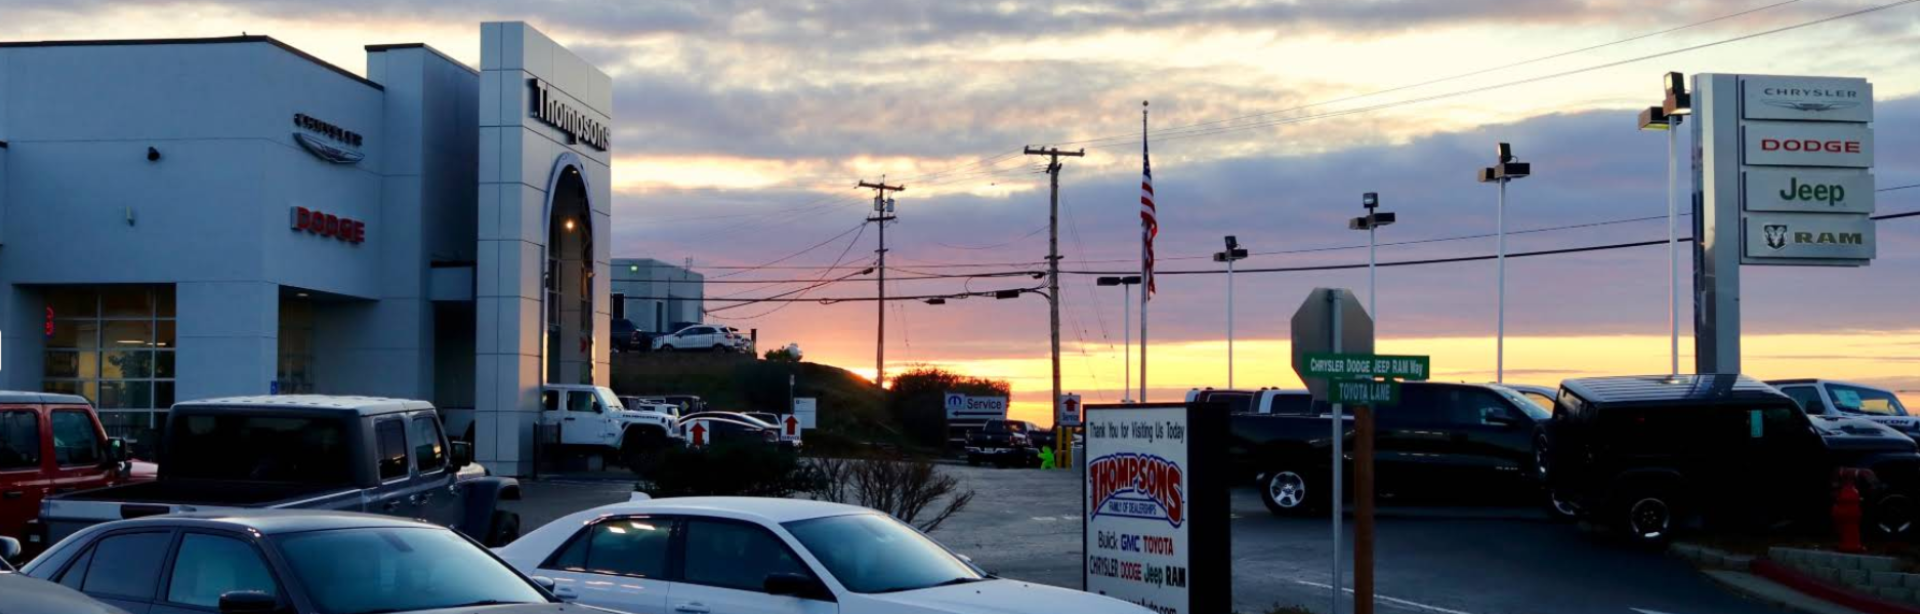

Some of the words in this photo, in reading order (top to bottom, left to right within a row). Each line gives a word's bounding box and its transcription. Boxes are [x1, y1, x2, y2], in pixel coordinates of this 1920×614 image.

[1763, 87, 1858, 98] CHRYSLER
[530, 78, 611, 151] Thompsons
[1761, 138, 1861, 154] DODGE
[1779, 176, 1845, 206] Jeep
[292, 205, 365, 244] DODGE
[1794, 231, 1863, 245] RAM
[1310, 358, 1344, 373] CHRYSLER
[1346, 359, 1370, 373] DODGE
[1373, 359, 1390, 373] JEEP
[1392, 359, 1408, 374] RAM
[1410, 360, 1423, 376] Way
[1339, 382, 1368, 400] TOYOTA
[1370, 383, 1390, 400] LANE
[967, 398, 1002, 410] Service
[1090, 422, 1106, 439] Thank
[1108, 421, 1118, 438] You
[1120, 421, 1129, 438] for
[1131, 421, 1153, 443] Visiting
[1155, 422, 1164, 438] Us
[1166, 421, 1184, 443] Today
[1089, 454, 1183, 527] THOMPSONS
[1109, 501, 1121, 513] FAMILY
[1123, 502, 1129, 513] OF
[1129, 502, 1157, 515] DEALERSHIPS
[1098, 530, 1118, 550] Buick
[1121, 534, 1141, 551] GMC
[1143, 536, 1174, 556] TOYOTA
[1089, 555, 1119, 578] CHRYSLER
[1120, 561, 1142, 581] DODGE
[1144, 564, 1163, 588] Jeep
[1166, 565, 1186, 588] RAM
